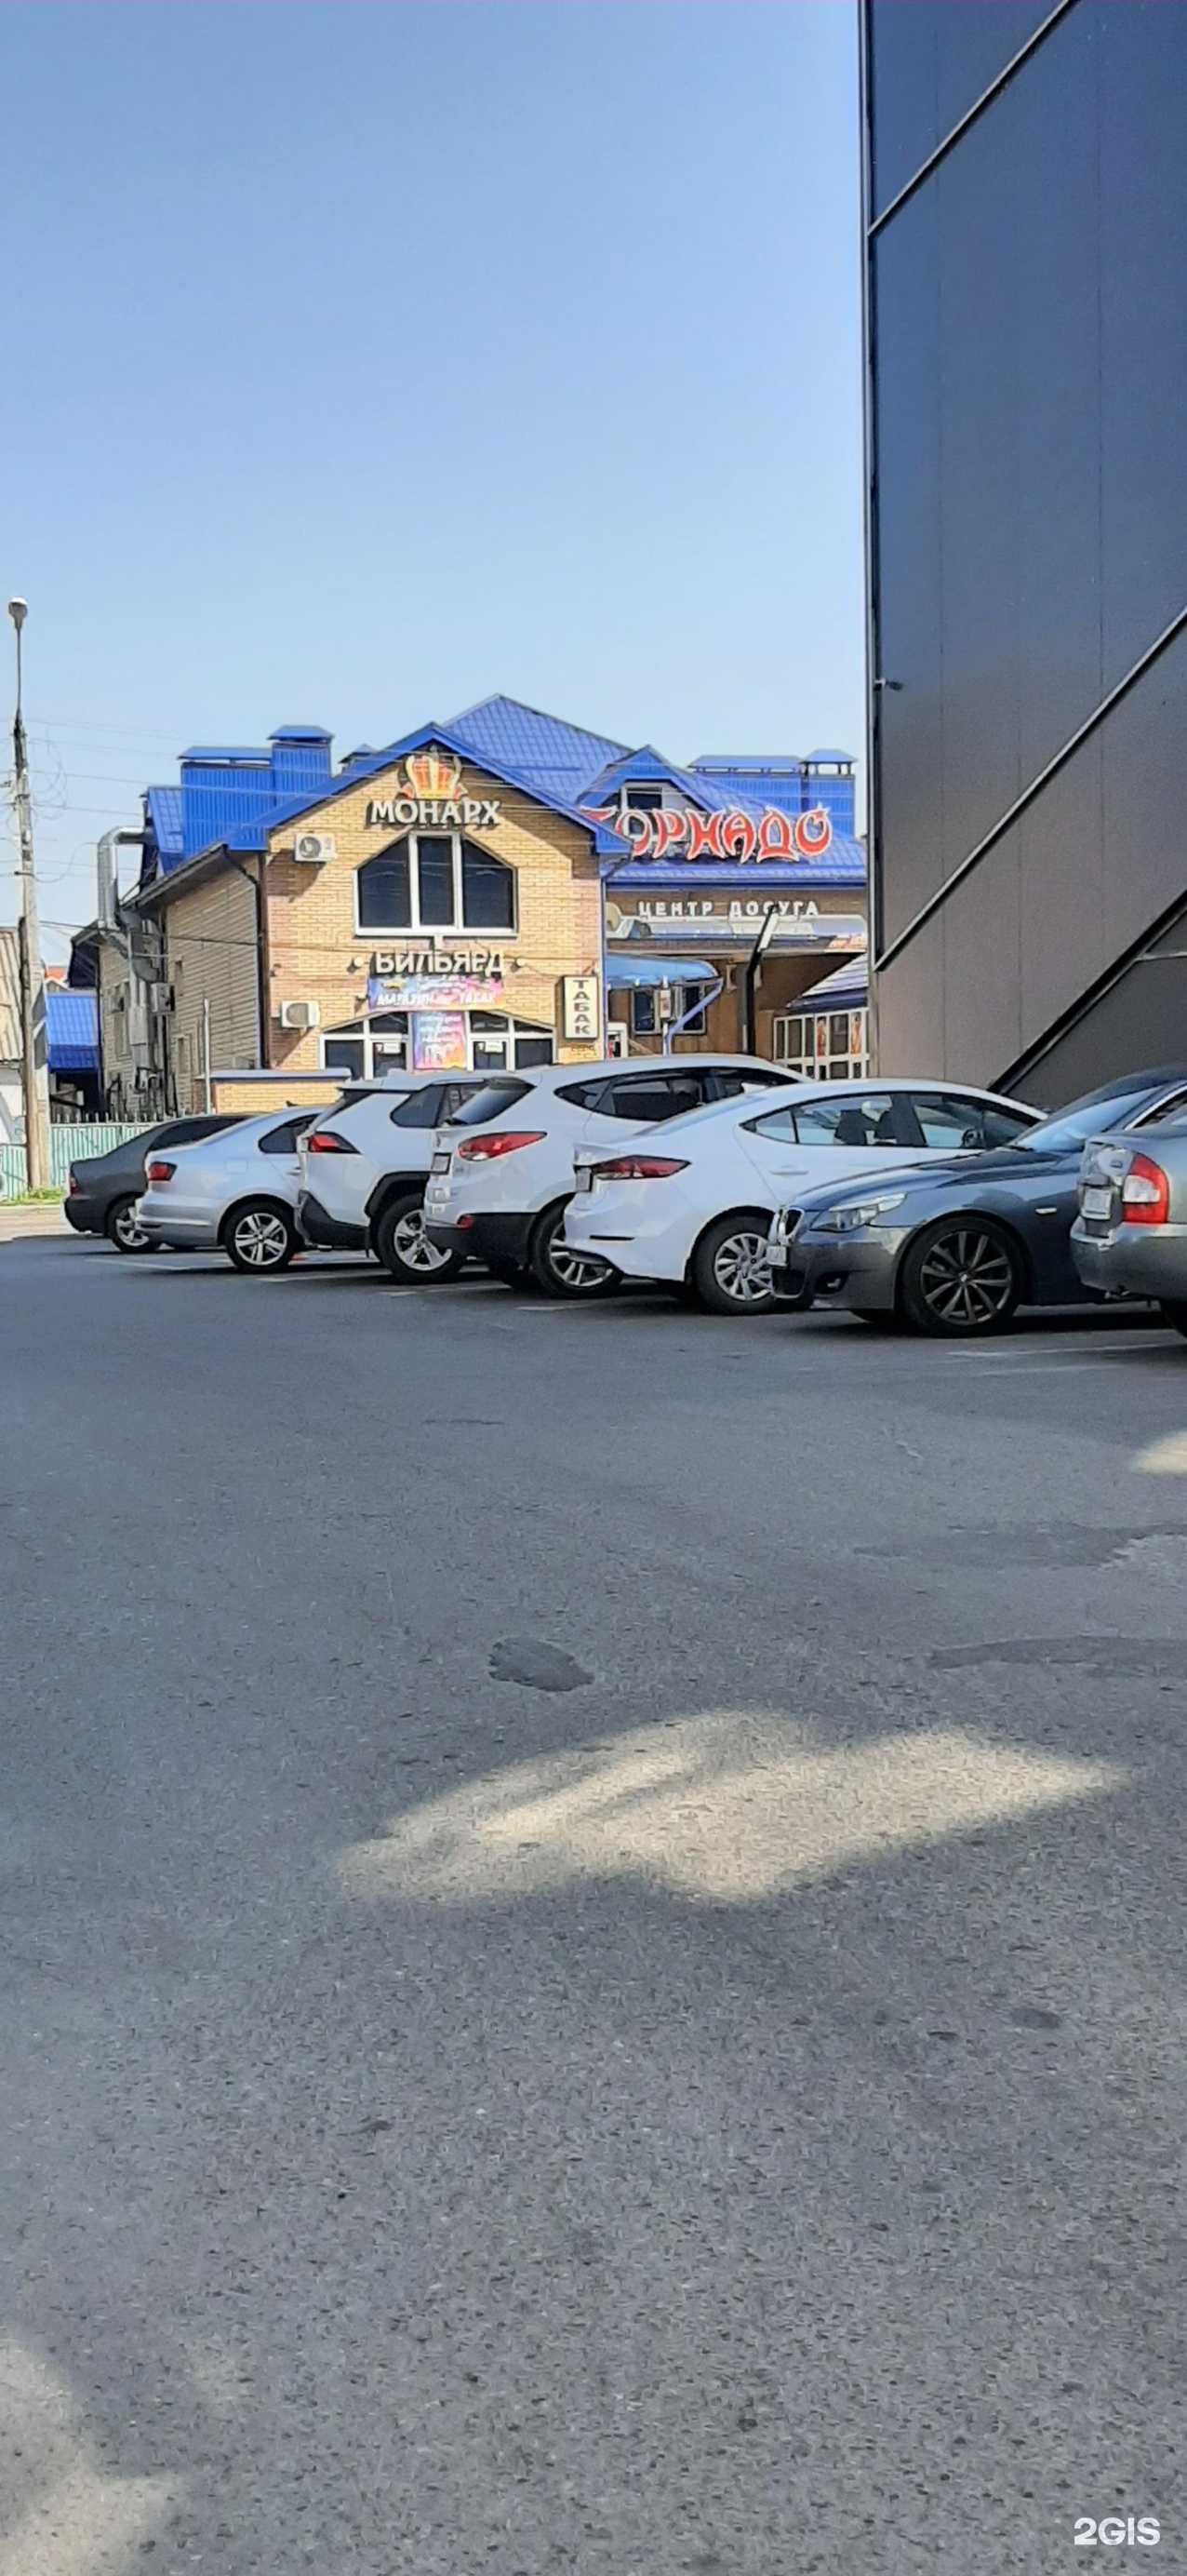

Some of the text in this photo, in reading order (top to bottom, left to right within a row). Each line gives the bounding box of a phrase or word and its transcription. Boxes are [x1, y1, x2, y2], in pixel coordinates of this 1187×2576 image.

[369, 799, 500, 825] МОНАРХ
[638, 900, 820, 918] ЦЕНТР ДОСУГА
[573, 979, 591, 1035] ТАБАК
